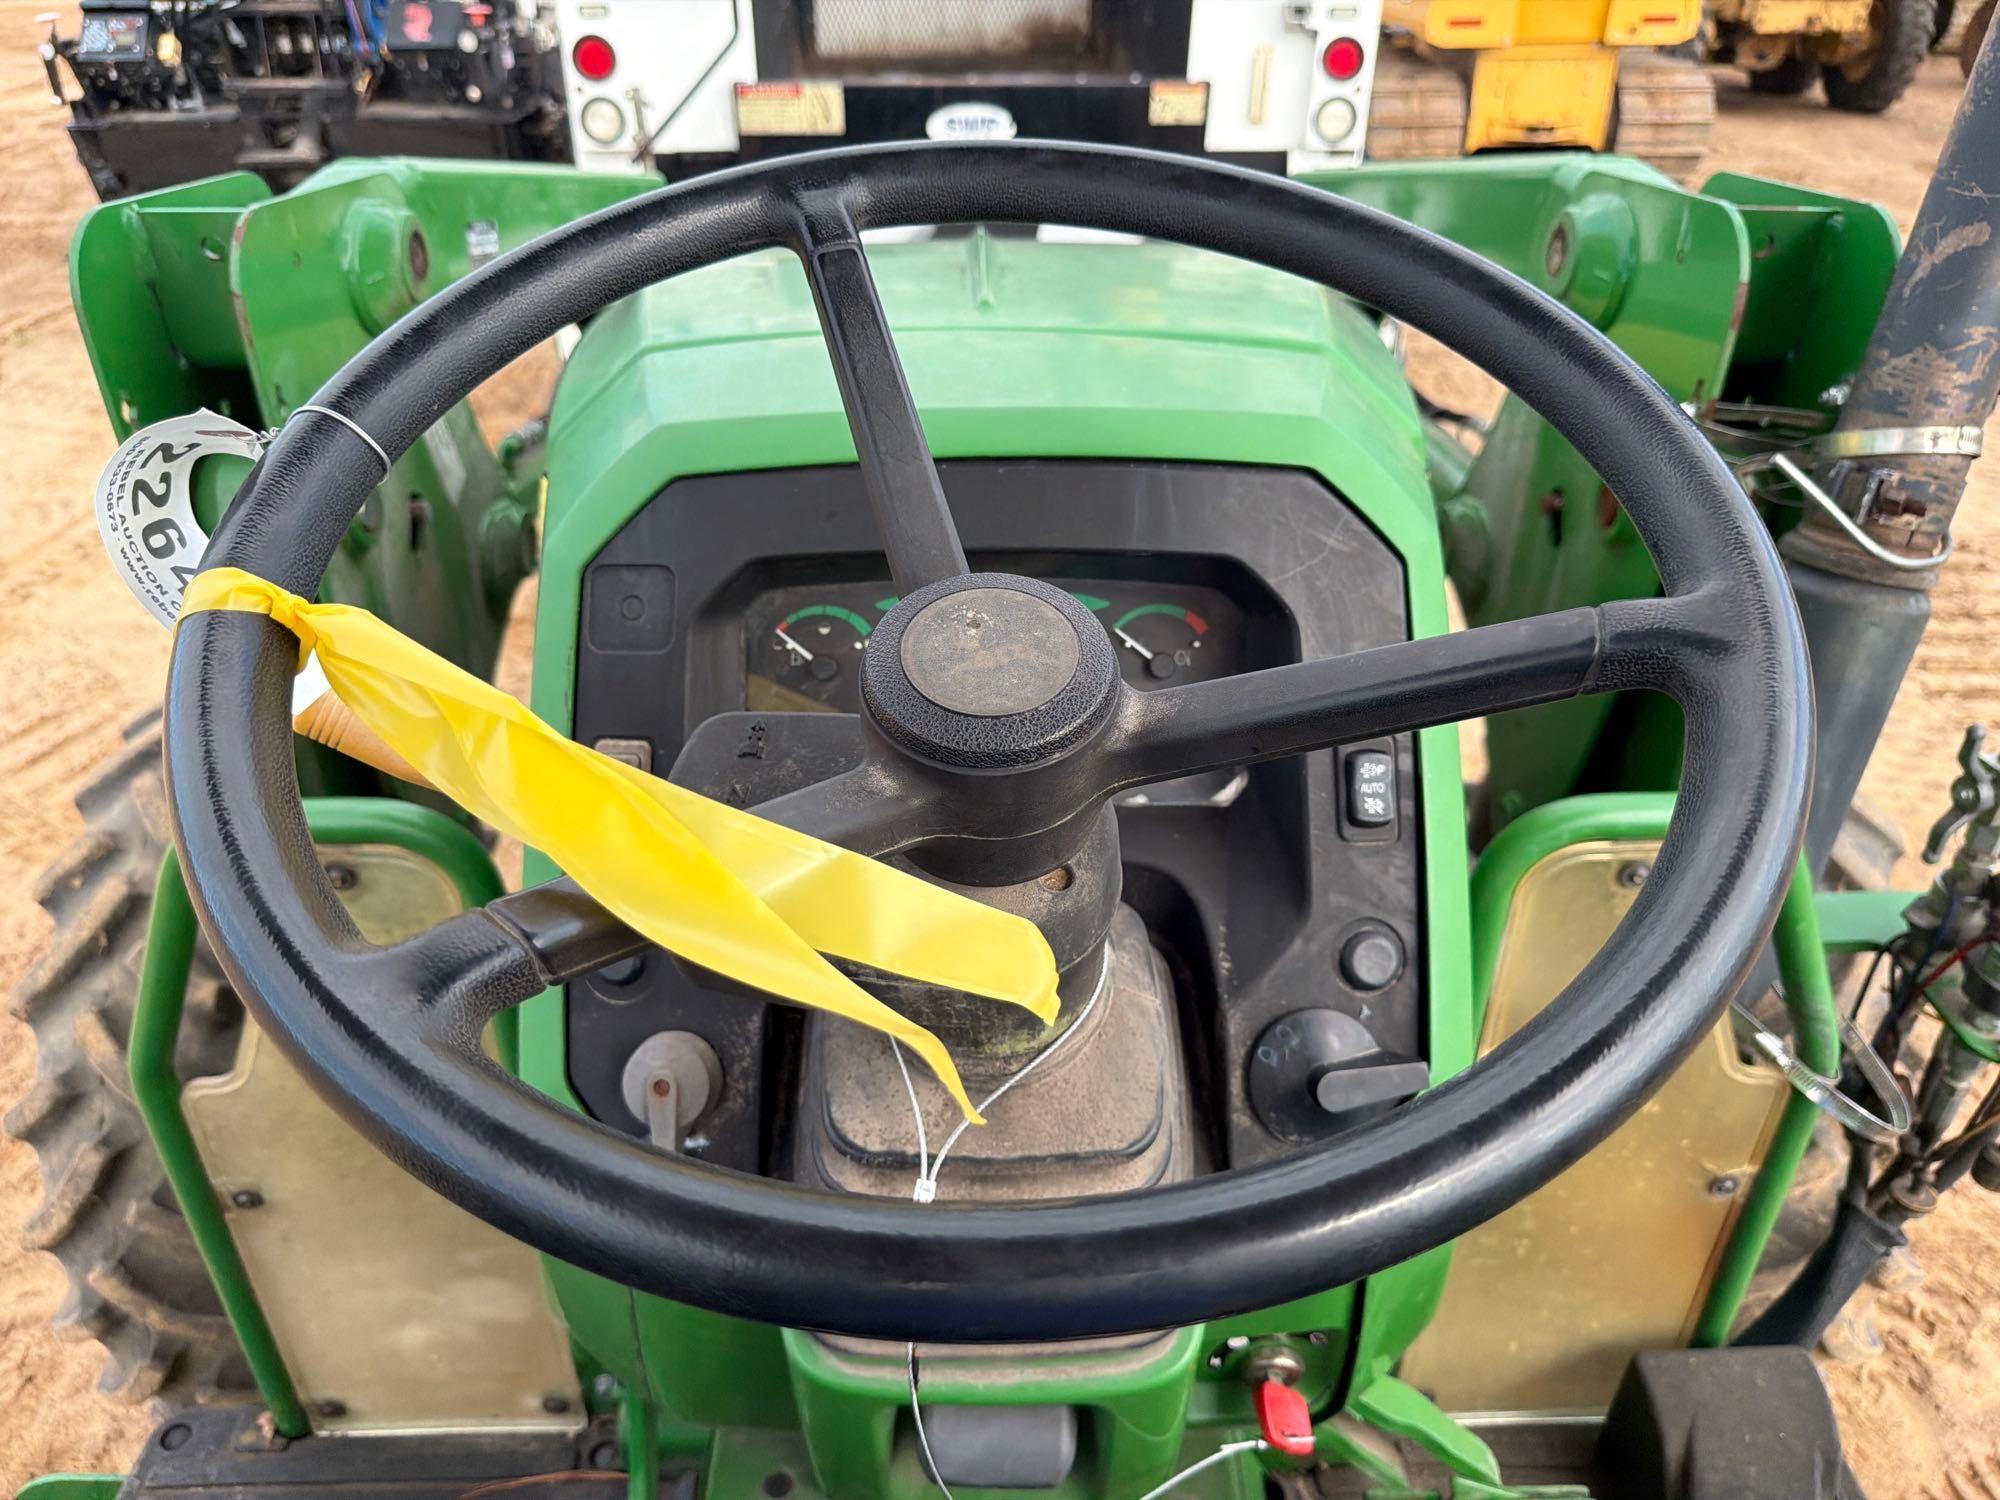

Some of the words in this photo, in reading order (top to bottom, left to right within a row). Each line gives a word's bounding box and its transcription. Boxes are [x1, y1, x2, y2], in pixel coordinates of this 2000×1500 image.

[116, 448, 146, 507] REBEL
[118, 514, 169, 596] AUCTION
[119, 547, 178, 623] www.rebe
[1360, 782, 1386, 794] AUTO
